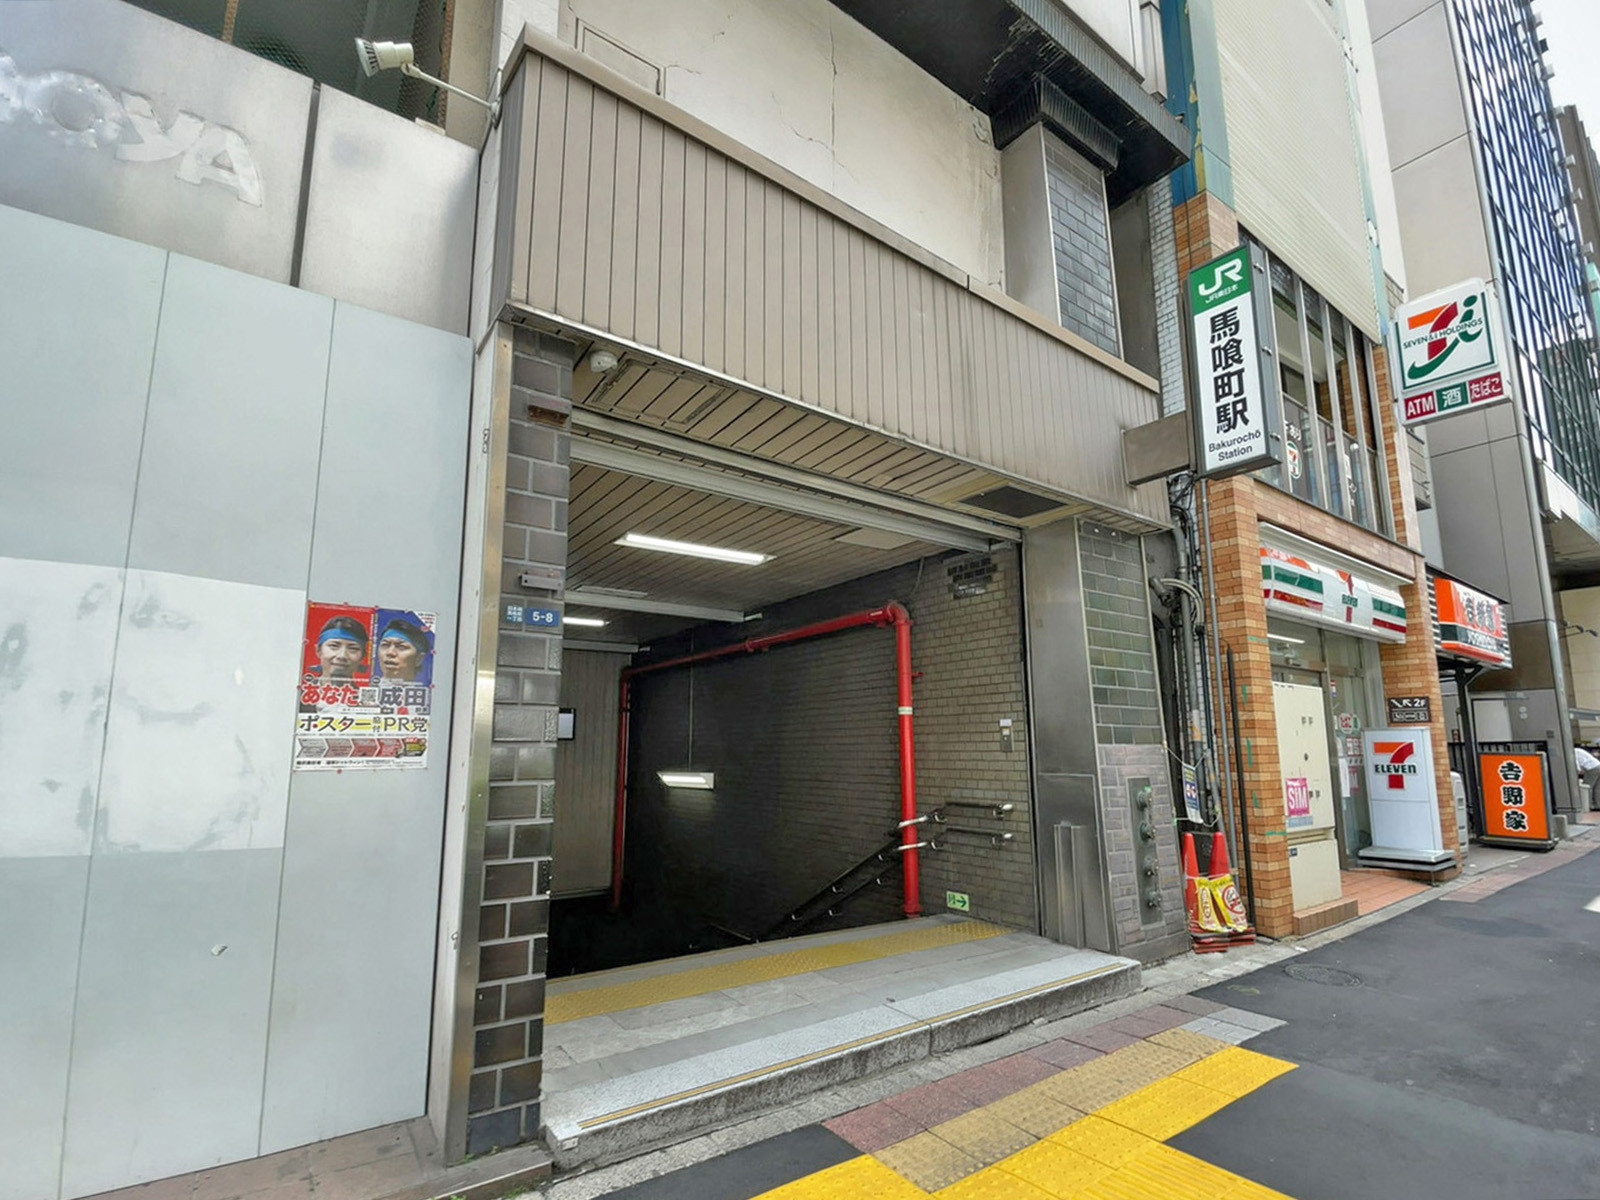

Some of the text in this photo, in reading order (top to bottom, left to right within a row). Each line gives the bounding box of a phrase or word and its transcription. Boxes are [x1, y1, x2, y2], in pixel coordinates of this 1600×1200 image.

[1198, 257, 1244, 297] JR
[1205, 284, 1239, 304] JR東日本
[1439, 318, 1484, 338] HOLDINGS
[1209, 305, 1251, 434] 馬喰町駅
[1441, 387, 1463, 408] 酒
[1470, 377, 1502, 399] たばこ
[1406, 395, 1435, 417] ATM
[1218, 445, 1253, 462] Station
[532, 611, 554, 623] 5-8
[301, 684, 358, 705] あなた
[380, 687, 427, 706] 成田
[1499, 761, 1528, 831] 吉野家
